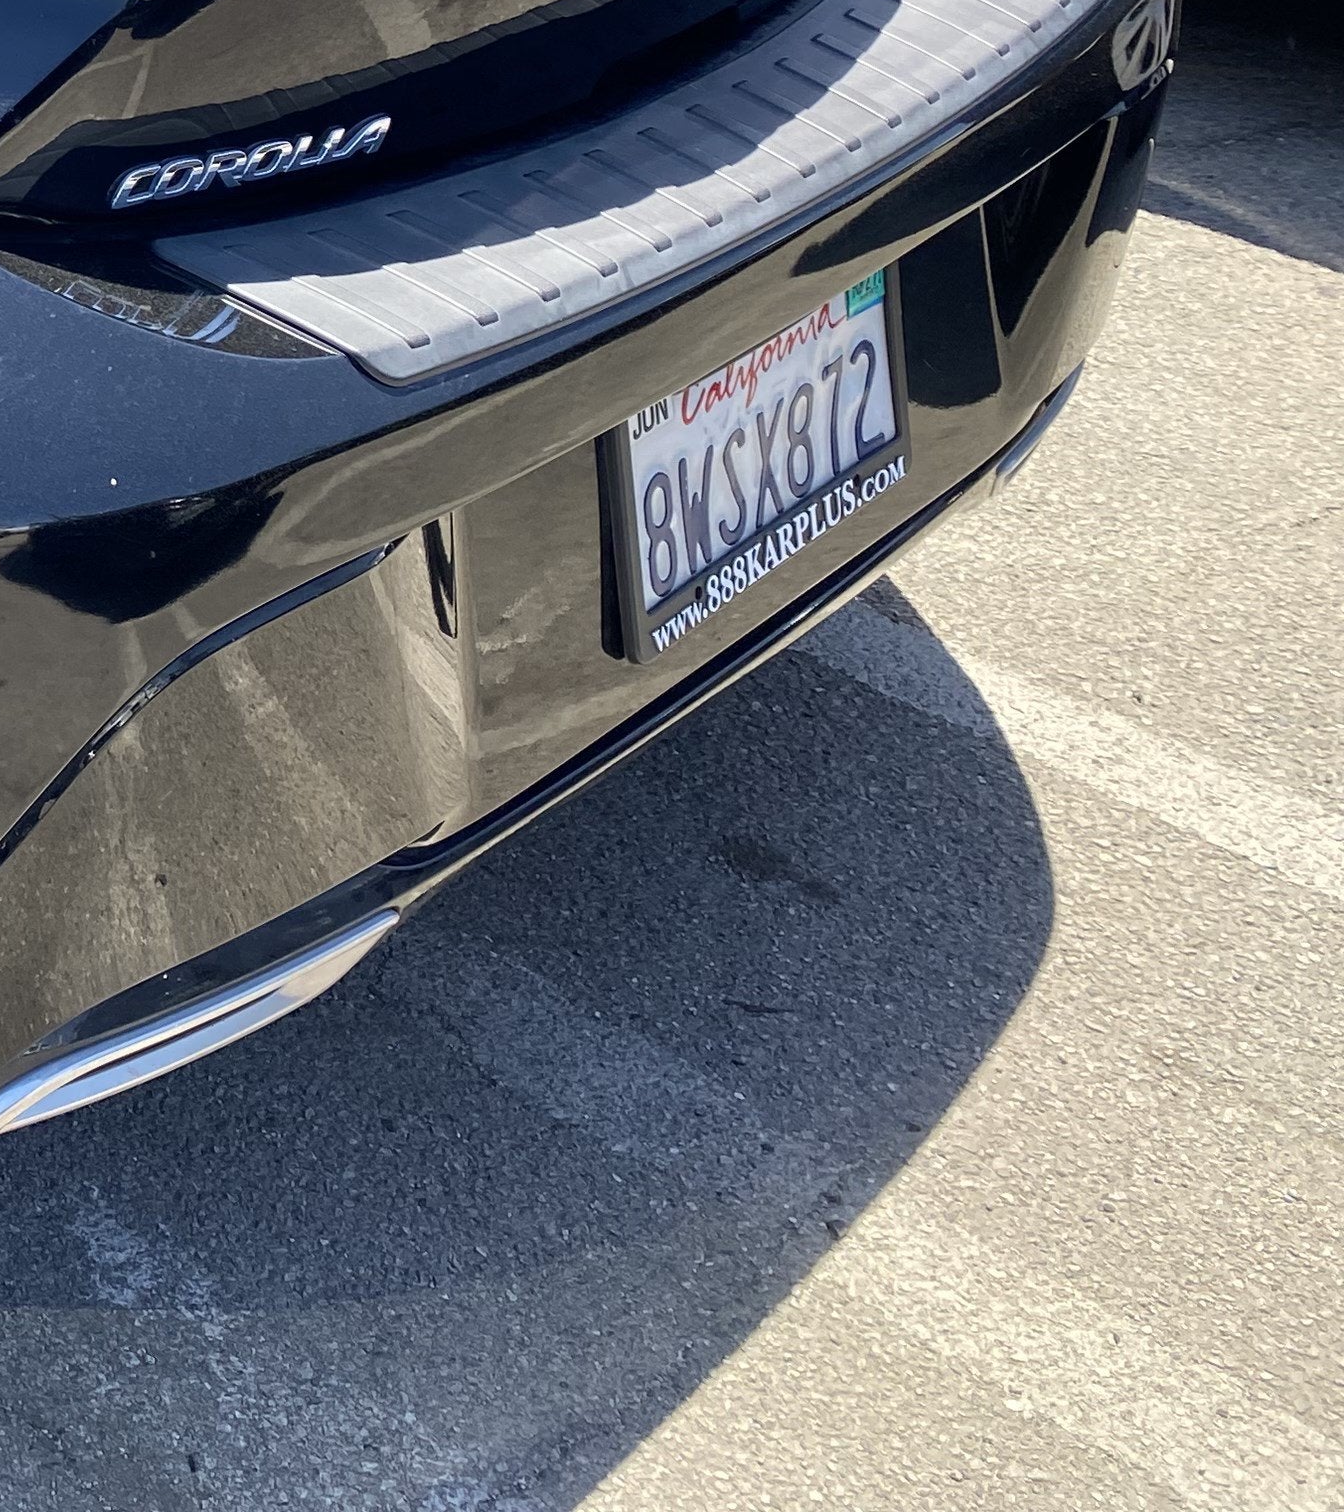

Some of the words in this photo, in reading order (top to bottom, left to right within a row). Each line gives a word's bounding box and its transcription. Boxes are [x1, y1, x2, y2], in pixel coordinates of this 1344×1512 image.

[109, 114, 392, 209] COROLLA
[680, 302, 847, 426] California
[632, 398, 670, 441] JUN
[643, 338, 886, 598] 8WSX872
